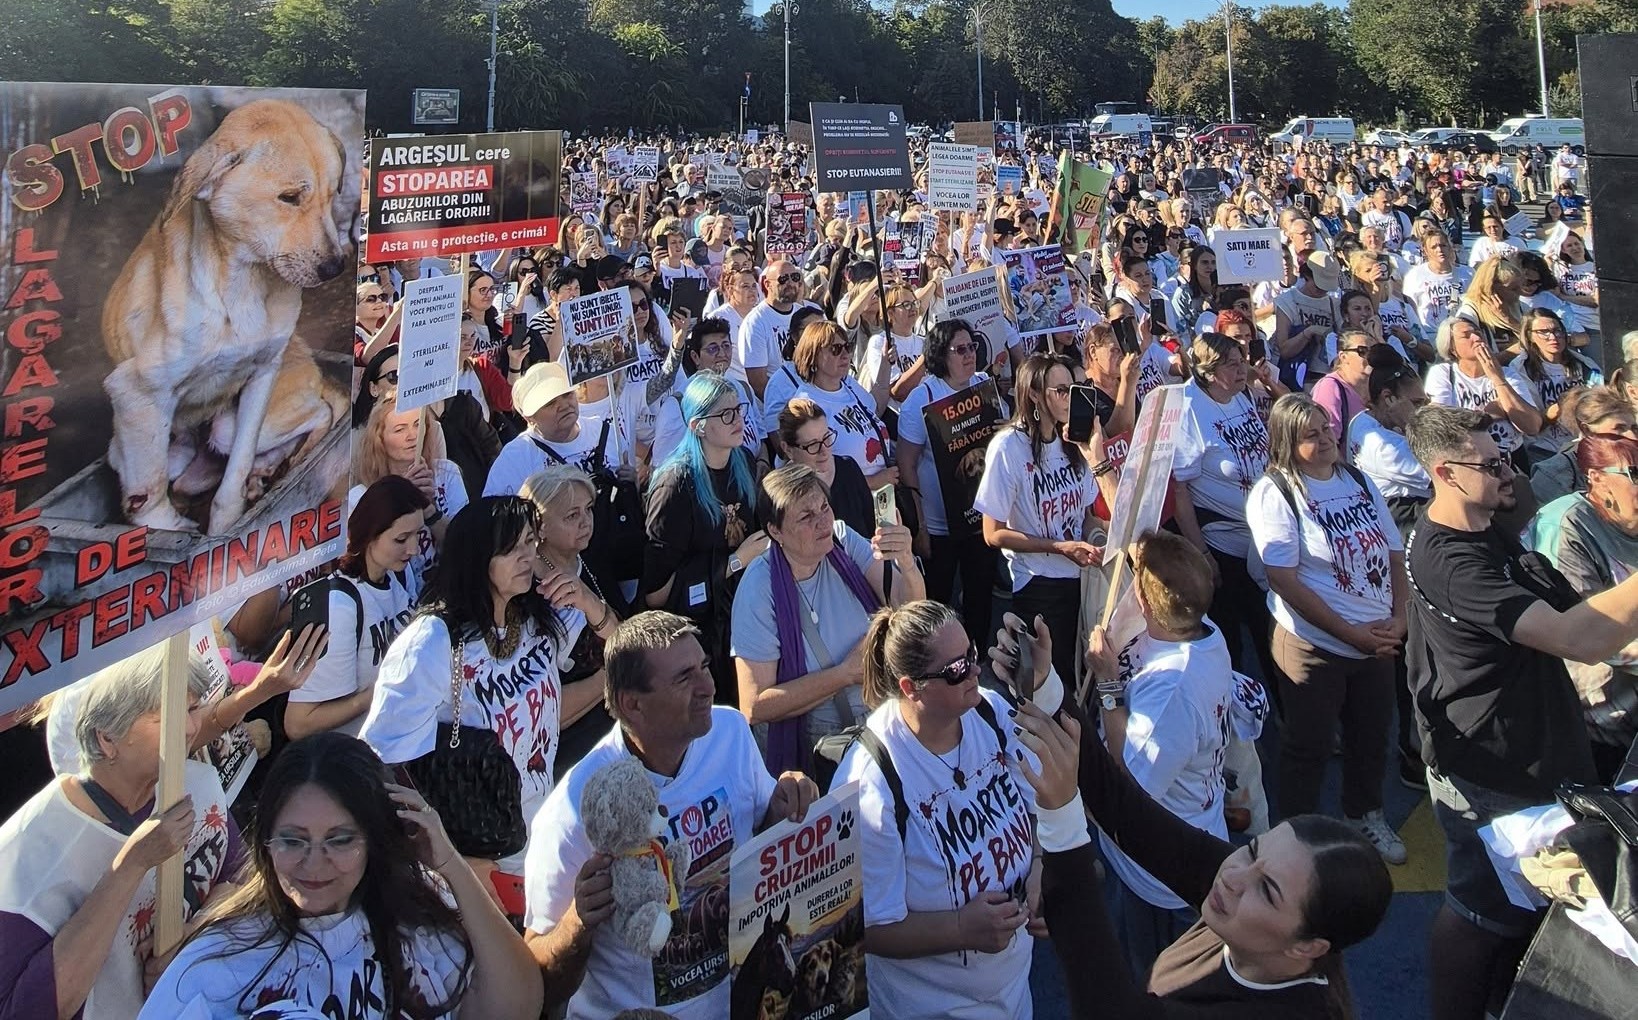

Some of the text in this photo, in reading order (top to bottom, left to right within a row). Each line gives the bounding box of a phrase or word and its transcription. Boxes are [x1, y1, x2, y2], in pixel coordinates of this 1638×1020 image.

[6, 92, 193, 212] STOP
[380, 144, 511, 166] ARGEȘUL cere
[382, 169, 489, 193] STOPAREA
[826, 169, 848, 178] STOP
[381, 193, 484, 210] ABUZURILOR DIN
[381, 240, 409, 252] Asta
[412, 238, 428, 249] nu
[431, 238, 439, 247] e
[501, 232, 508, 240] e
[1226, 240, 1270, 251] SATU MARE
[418, 285, 444, 295] DREPTATE
[971, 279, 980, 288] DE
[409, 307, 425, 316] VOCE
[425, 302, 446, 314] PENTRU
[410, 292, 456, 306] PENTRU ANIMALE
[570, 302, 579, 313] NU
[580, 297, 598, 310] SUNT
[571, 312, 581, 323] NU
[582, 306, 601, 320] SUNT
[574, 316, 602, 336] SUNT
[424, 359, 434, 368] NU
[942, 395, 981, 421] 15.000
[951, 414, 982, 434] AU MURIT
[948, 426, 991, 453] FĂRĂ VOCE
[967, 513, 983, 525] VOC
[1042, 497, 1059, 519] PE
[1317, 500, 1378, 538] MOARTE
[74, 524, 149, 589] DE
[1335, 535, 1358, 559] PE
[195, 595, 224, 616] Foto
[313, 541, 337, 560] Peta
[0, 500, 342, 690] XTERMINARE
[475, 639, 553, 712] MOARTE
[495, 703, 525, 748] PE
[668, 795, 719, 840] TOP
[935, 771, 1019, 862] MOARTE
[688, 813, 732, 859] TOARE!
[760, 814, 833, 877] STOP
[754, 842, 836, 903] CRUZIMII
[794, 852, 855, 898] ANIMALELOR!
[960, 852, 991, 904] PE
[807, 879, 853, 910] DUREREA LOR
[809, 902, 826, 920] ESTE
[670, 964, 703, 989] VOCEA
